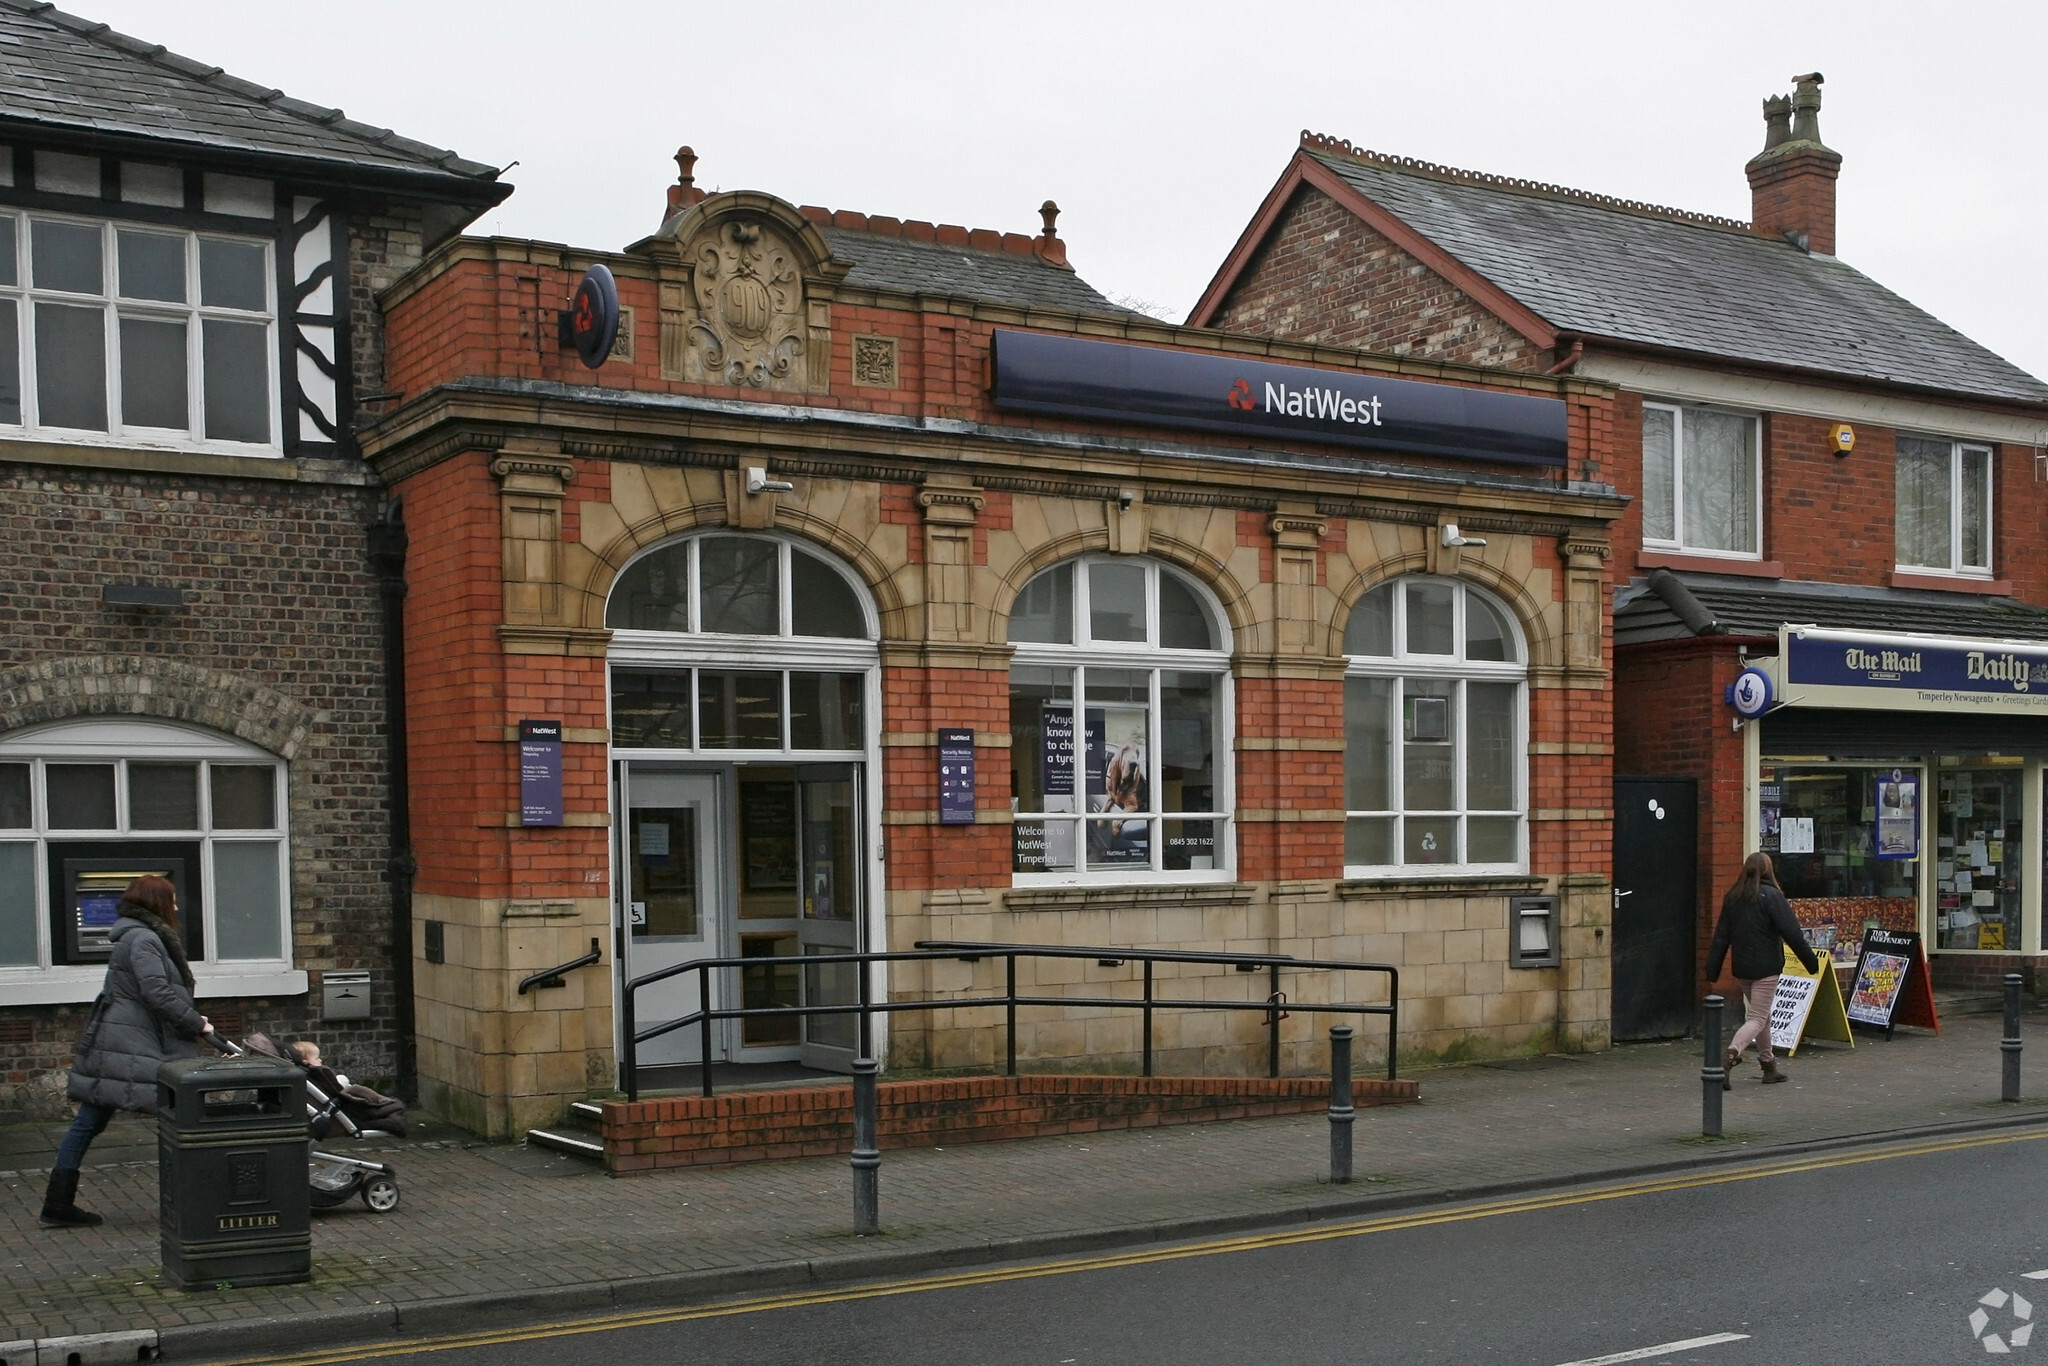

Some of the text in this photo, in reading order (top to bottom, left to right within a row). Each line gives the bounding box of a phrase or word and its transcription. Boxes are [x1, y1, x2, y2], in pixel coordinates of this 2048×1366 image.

[1265, 381, 1382, 426] NatWest
[1845, 648, 1921, 672] The Mail
[1966, 651, 2030, 693] Daily
[1917, 691, 1953, 704] Timperley
[1954, 693, 1994, 705] Newsagents
[2003, 695, 2031, 707] Greetings
[1046, 727, 1072, 738] know
[1047, 740, 1057, 750] to
[1047, 755, 1054, 763] a
[1017, 826, 1065, 836] Welcome to
[1017, 840, 1052, 849] NatWest
[1169, 838, 1214, 846] 0845 302 1622
[1017, 853, 1057, 866] Timperley
[1870, 935, 1912, 945] INDEPENDENT
[1779, 979, 1811, 990] FAMILY'S
[1776, 989, 1808, 1000] ANGUISH
[1776, 1000, 1797, 1010] OVER
[1772, 1010, 1795, 1021] RIVER
[1770, 1020, 1791, 1030] BODY
[220, 1215, 277, 1229] LITTER
